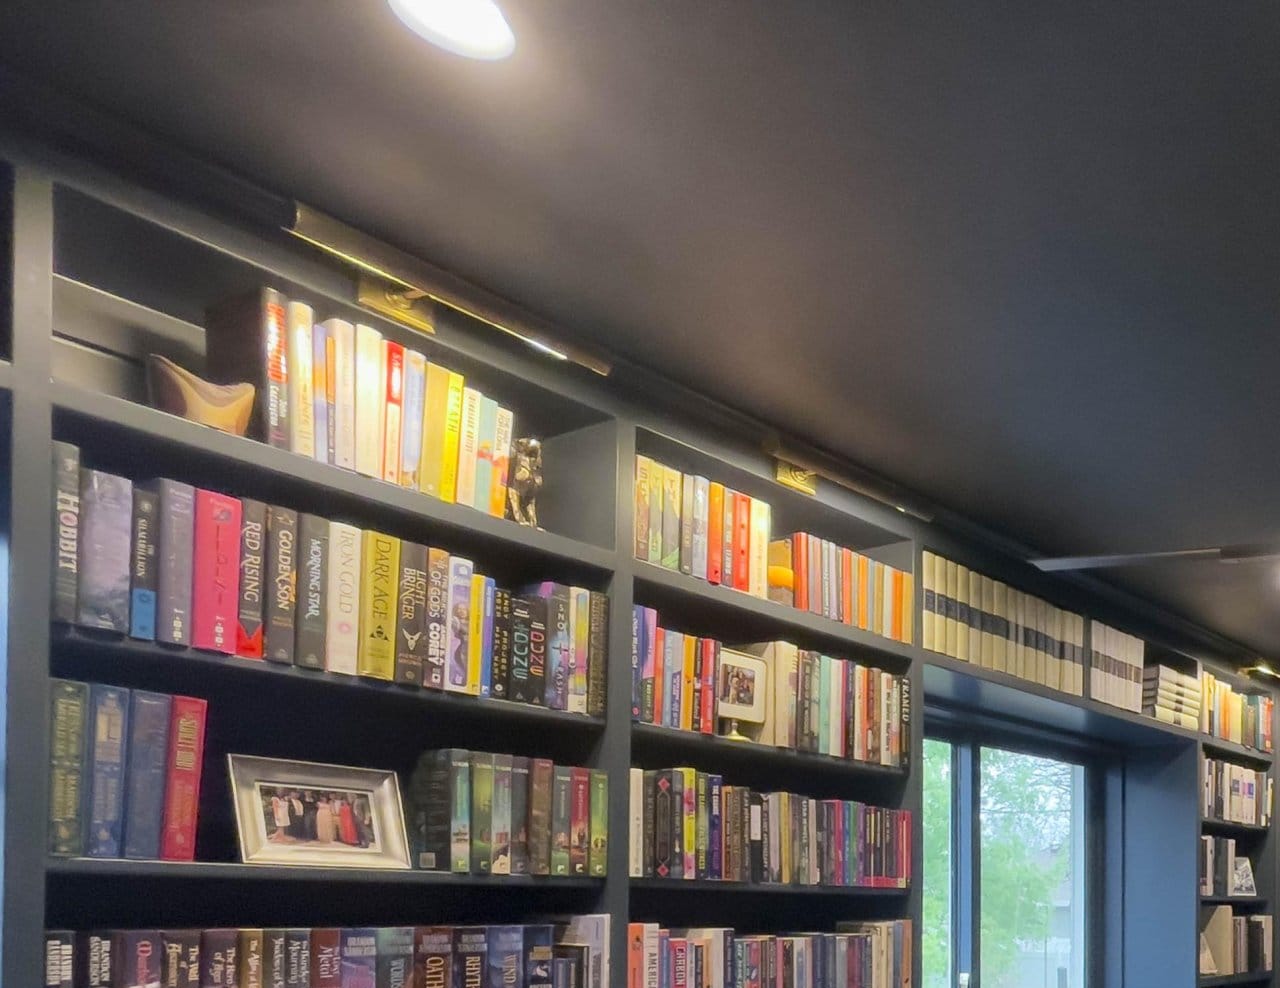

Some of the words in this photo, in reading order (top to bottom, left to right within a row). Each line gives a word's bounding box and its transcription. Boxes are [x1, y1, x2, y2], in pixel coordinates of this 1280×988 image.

[57, 490, 80, 573] HOBBIT
[241, 521, 262, 550] RED
[339, 530, 356, 567] IRON
[275, 530, 293, 580] GOLDEN
[306, 538, 322, 600] MORNING
[371, 538, 392, 585] DARK
[240, 553, 261, 612] RISING
[339, 571, 353, 614] GOLD
[400, 567, 416, 620] BRINGER
[415, 570, 428, 607] LIGHT
[430, 571, 442, 586] OF
[277, 587, 292, 620] SON
[304, 601, 321, 630] STAR
[371, 586, 390, 618] AGE
[429, 587, 441, 618] GODS
[428, 622, 441, 666] COREY
[901, 678, 911, 722] FRAMED
[47, 940, 61, 986] SANDERSON
[60, 944, 73, 981] BRANDON
[89, 936, 102, 986] SANDERSON
[101, 940, 111, 982] BRANDON
[225, 947, 237, 964] The
[225, 965, 237, 985] Hero
[317, 945, 334, 979] Metal
